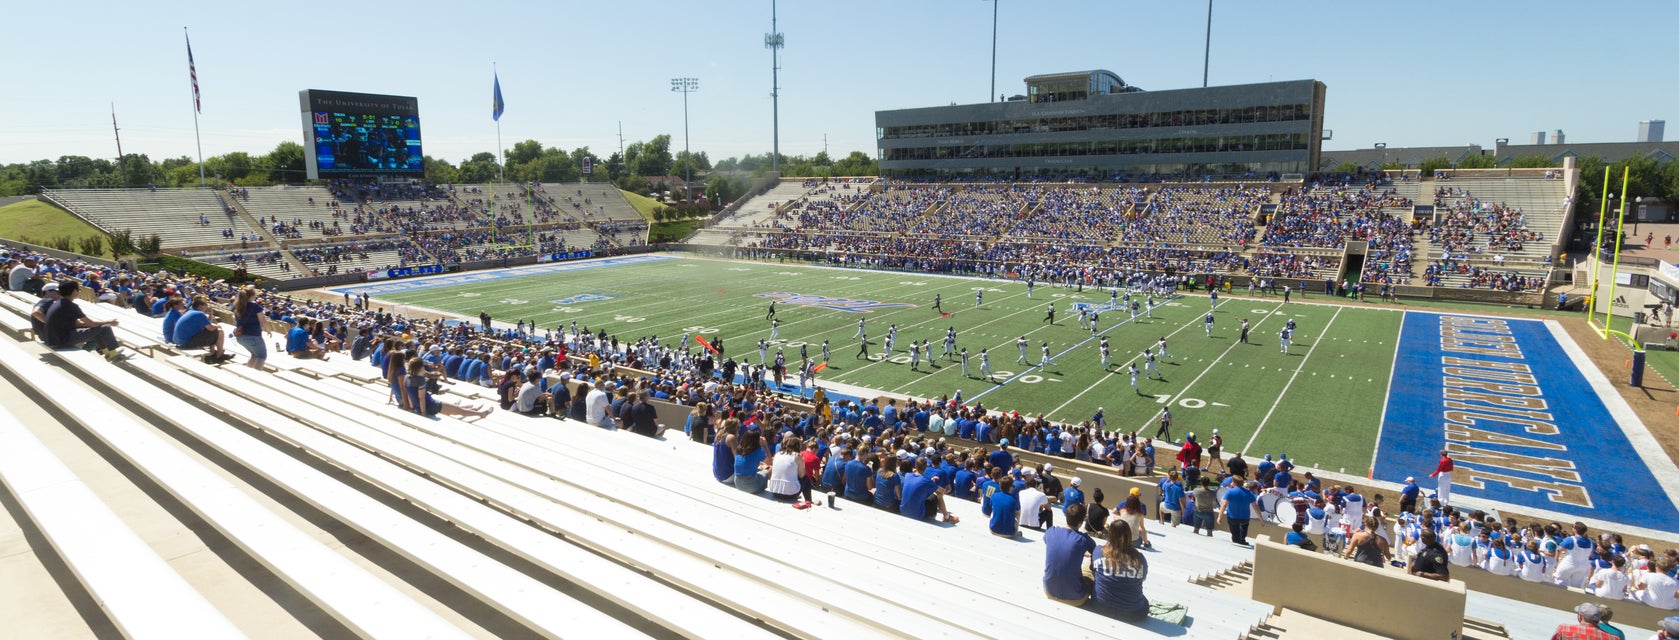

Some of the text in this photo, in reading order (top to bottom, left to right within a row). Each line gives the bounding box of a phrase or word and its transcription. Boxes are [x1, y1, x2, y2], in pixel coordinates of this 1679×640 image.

[986, 369, 1044, 385] 20
[1153, 393, 1207, 410] 10
[1441, 355, 1594, 509] HURRICANE
